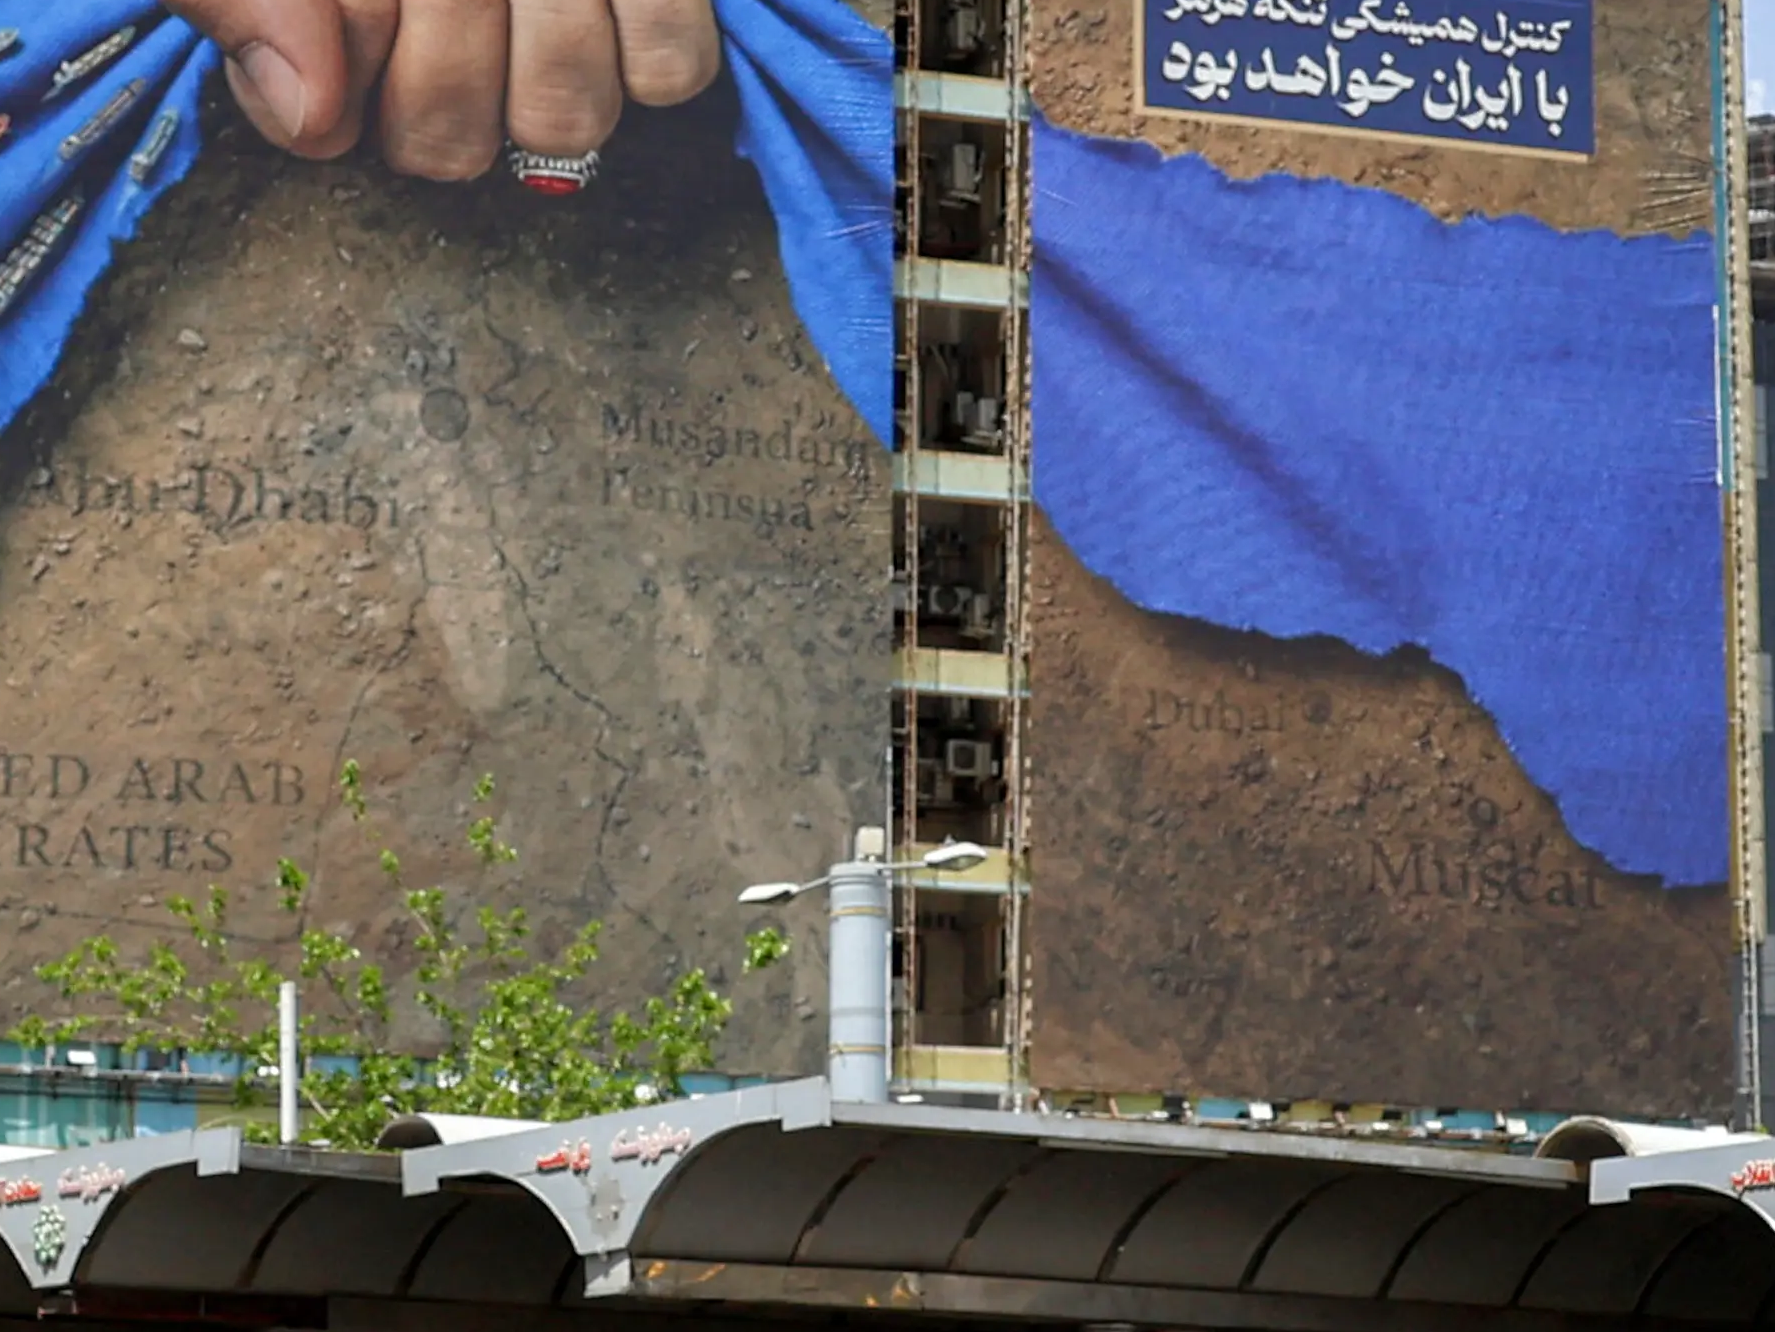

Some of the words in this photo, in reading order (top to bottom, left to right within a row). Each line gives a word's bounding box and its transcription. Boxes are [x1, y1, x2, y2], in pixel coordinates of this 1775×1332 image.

[1480, 12, 1572, 58] کنترل
[1162, 39, 1239, 103] بود
[1244, 43, 1415, 118] خواهد
[1423, 56, 1522, 131] ایران
[1534, 69, 1571, 138] با
[117, 757, 306, 805] ARAB
